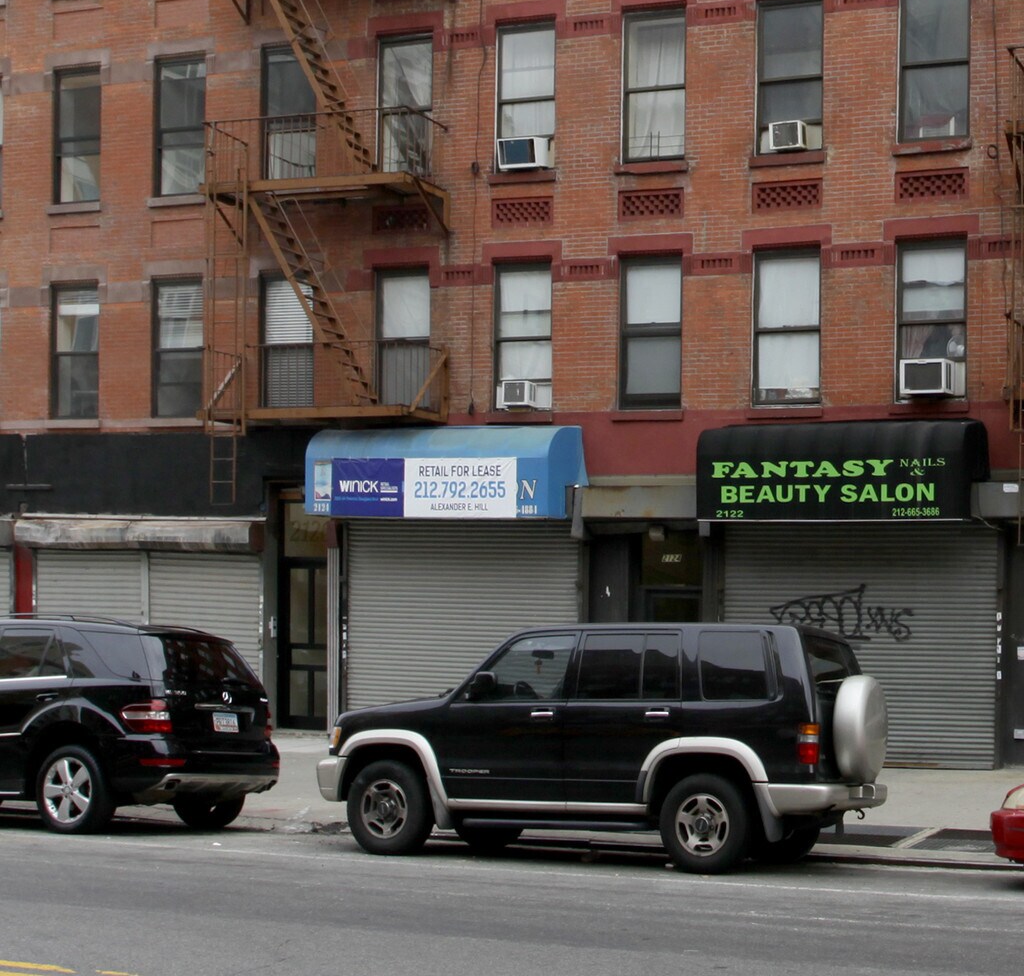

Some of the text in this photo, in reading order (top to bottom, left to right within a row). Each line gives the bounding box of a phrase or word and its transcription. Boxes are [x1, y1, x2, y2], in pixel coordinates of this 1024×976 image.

[711, 459, 894, 478] FANTASY
[900, 458, 946, 468] NAILS
[419, 465, 501, 477] RETAIL FOR LEASE
[910, 468, 925, 476] &
[340, 480, 379, 493] WINICK
[414, 481, 506, 498] 212.792.2655
[721, 483, 935, 503] BEAUTY SALON
[430, 503, 466, 511] ALEXANDER
[474, 503, 488, 511] HILL
[892, 507, 940, 517] 212-665-3686
[716, 510, 744, 518] 2122
